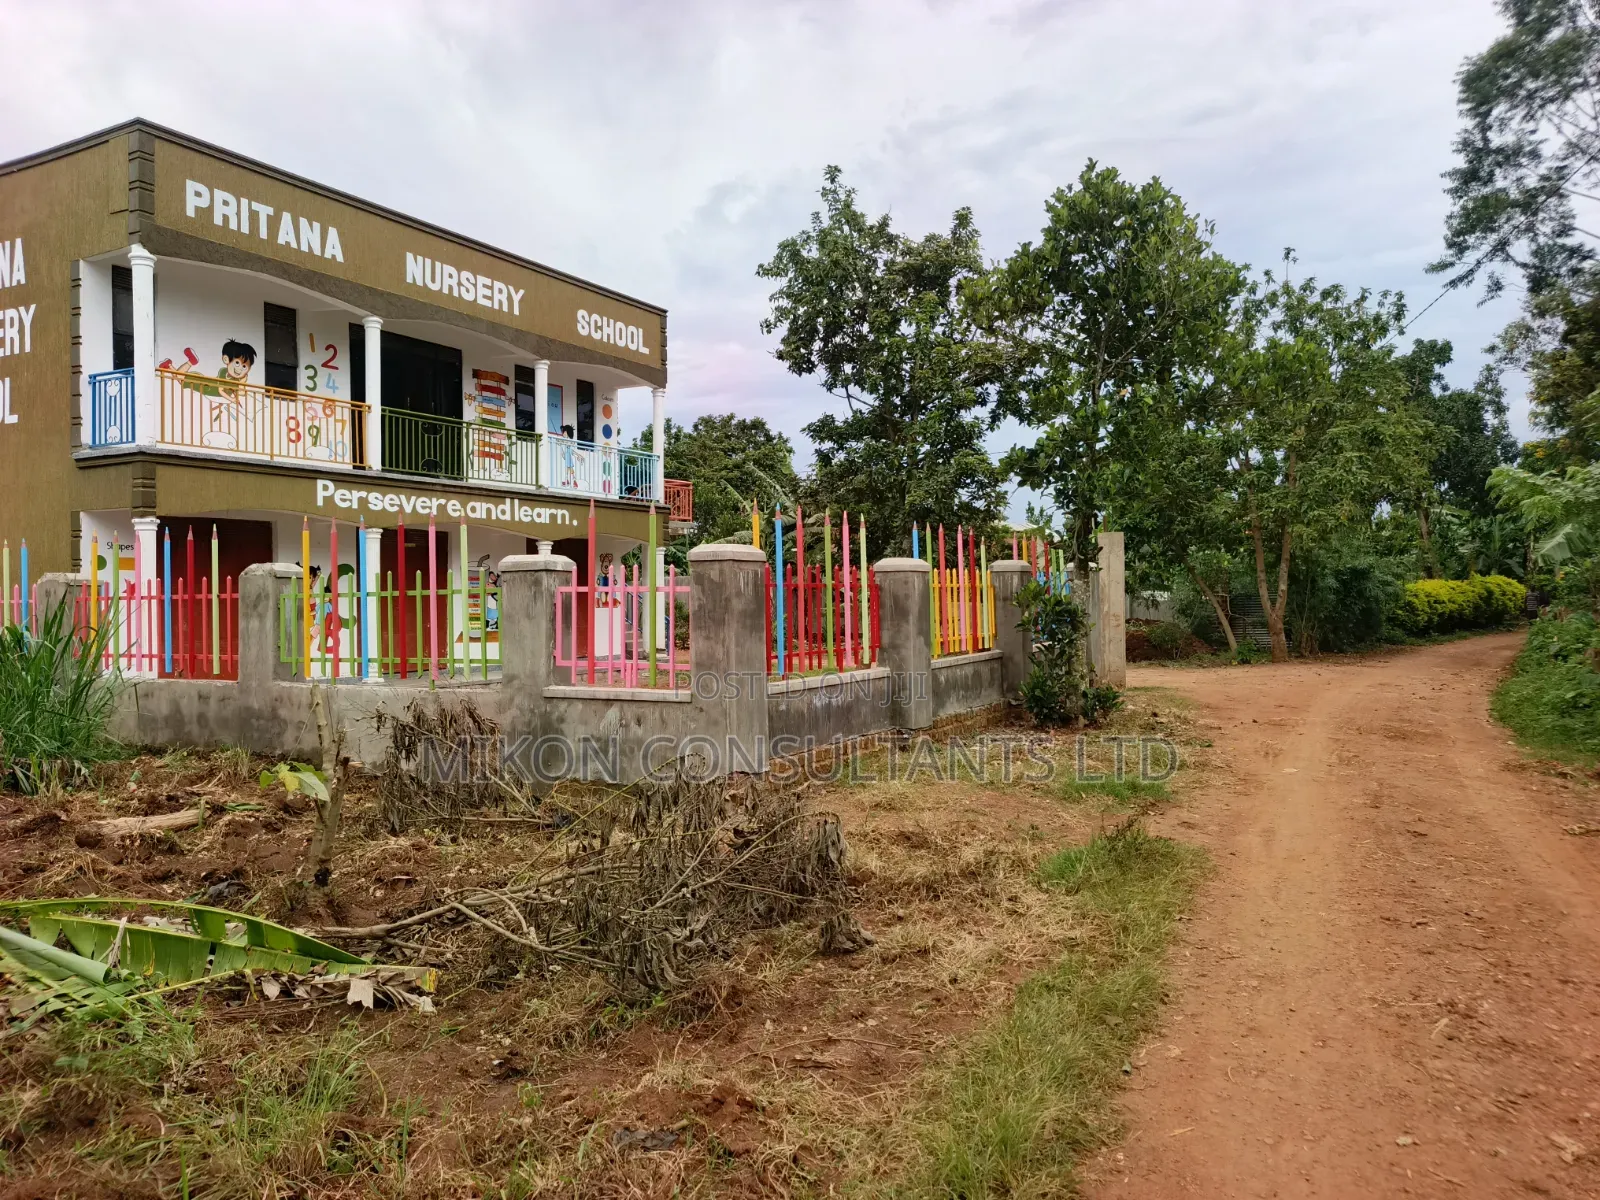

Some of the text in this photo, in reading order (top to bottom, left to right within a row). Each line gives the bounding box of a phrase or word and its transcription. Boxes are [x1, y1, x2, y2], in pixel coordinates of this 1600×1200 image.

[185, 179, 650, 355] PRITANA NURSERY SCHOOL
[321, 344, 339, 370] 2
[304, 364, 339, 394] 3 4
[0, 377, 18, 424] L
[316, 479, 578, 527] Persevere and learn.
[106, 541, 135, 552] Spes
